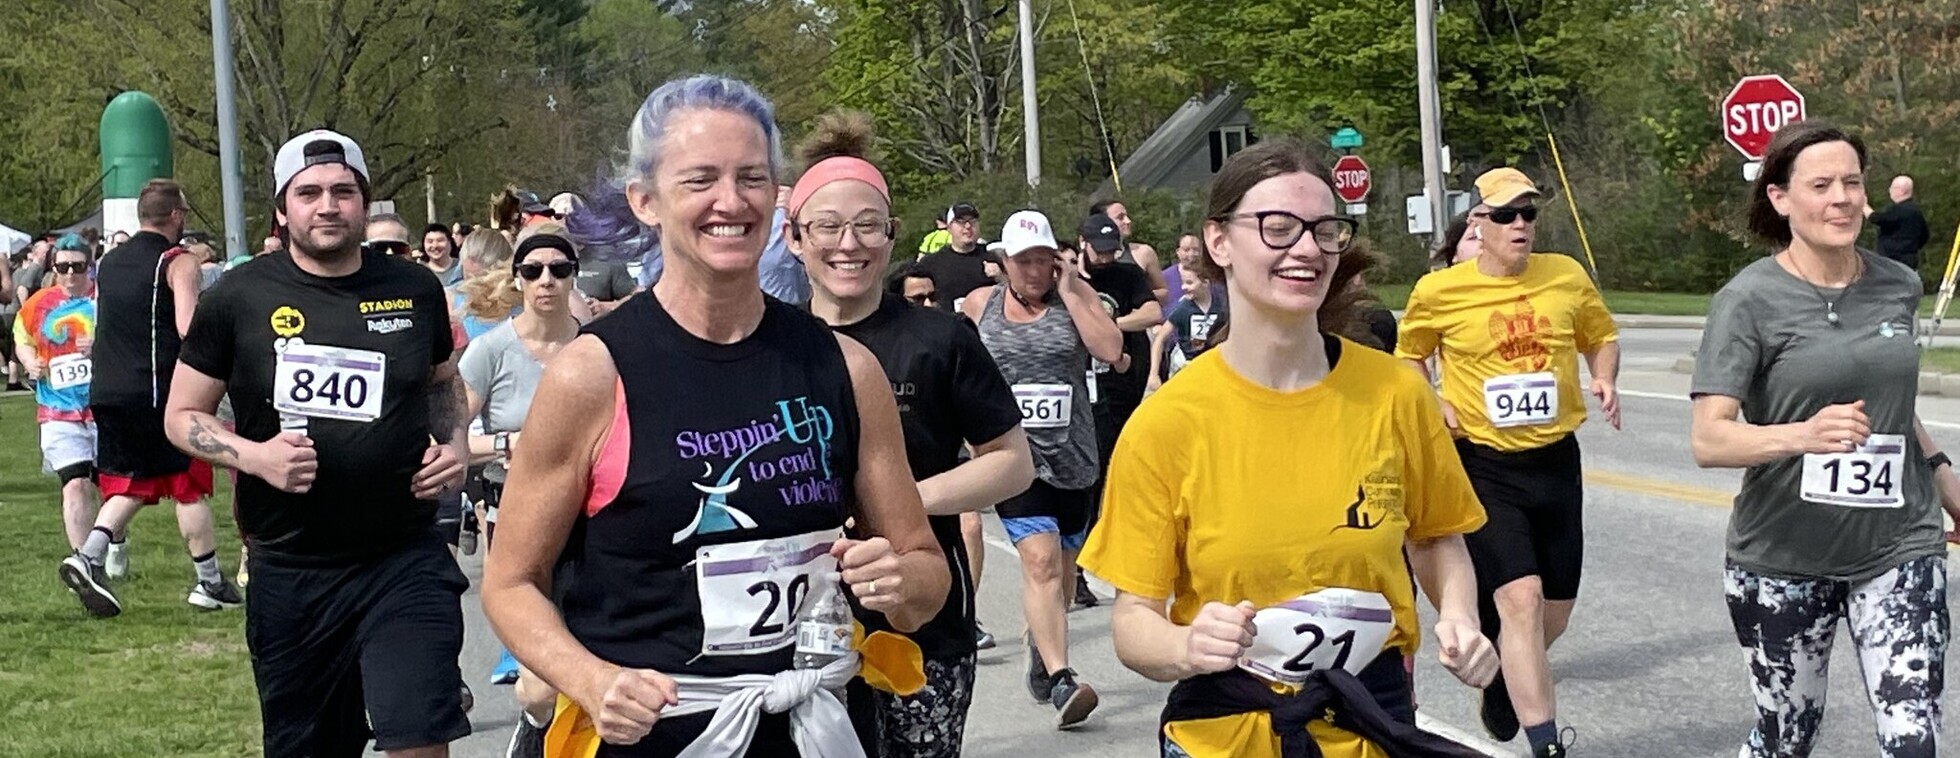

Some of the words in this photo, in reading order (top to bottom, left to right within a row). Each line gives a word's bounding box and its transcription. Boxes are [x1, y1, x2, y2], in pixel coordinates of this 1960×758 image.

[1730, 100, 1799, 135] STOP
[1335, 170, 1367, 189] STOP
[359, 299, 413, 313] STADION
[56, 363, 88, 382] 139
[289, 368, 368, 409] 840
[1021, 398, 1063, 420] 561
[1496, 390, 1550, 419] 944
[775, 396, 833, 480] Up
[749, 459, 776, 482] to
[778, 446, 817, 475] end
[1822, 458, 1893, 496] 134
[1282, 623, 1356, 672] 21
